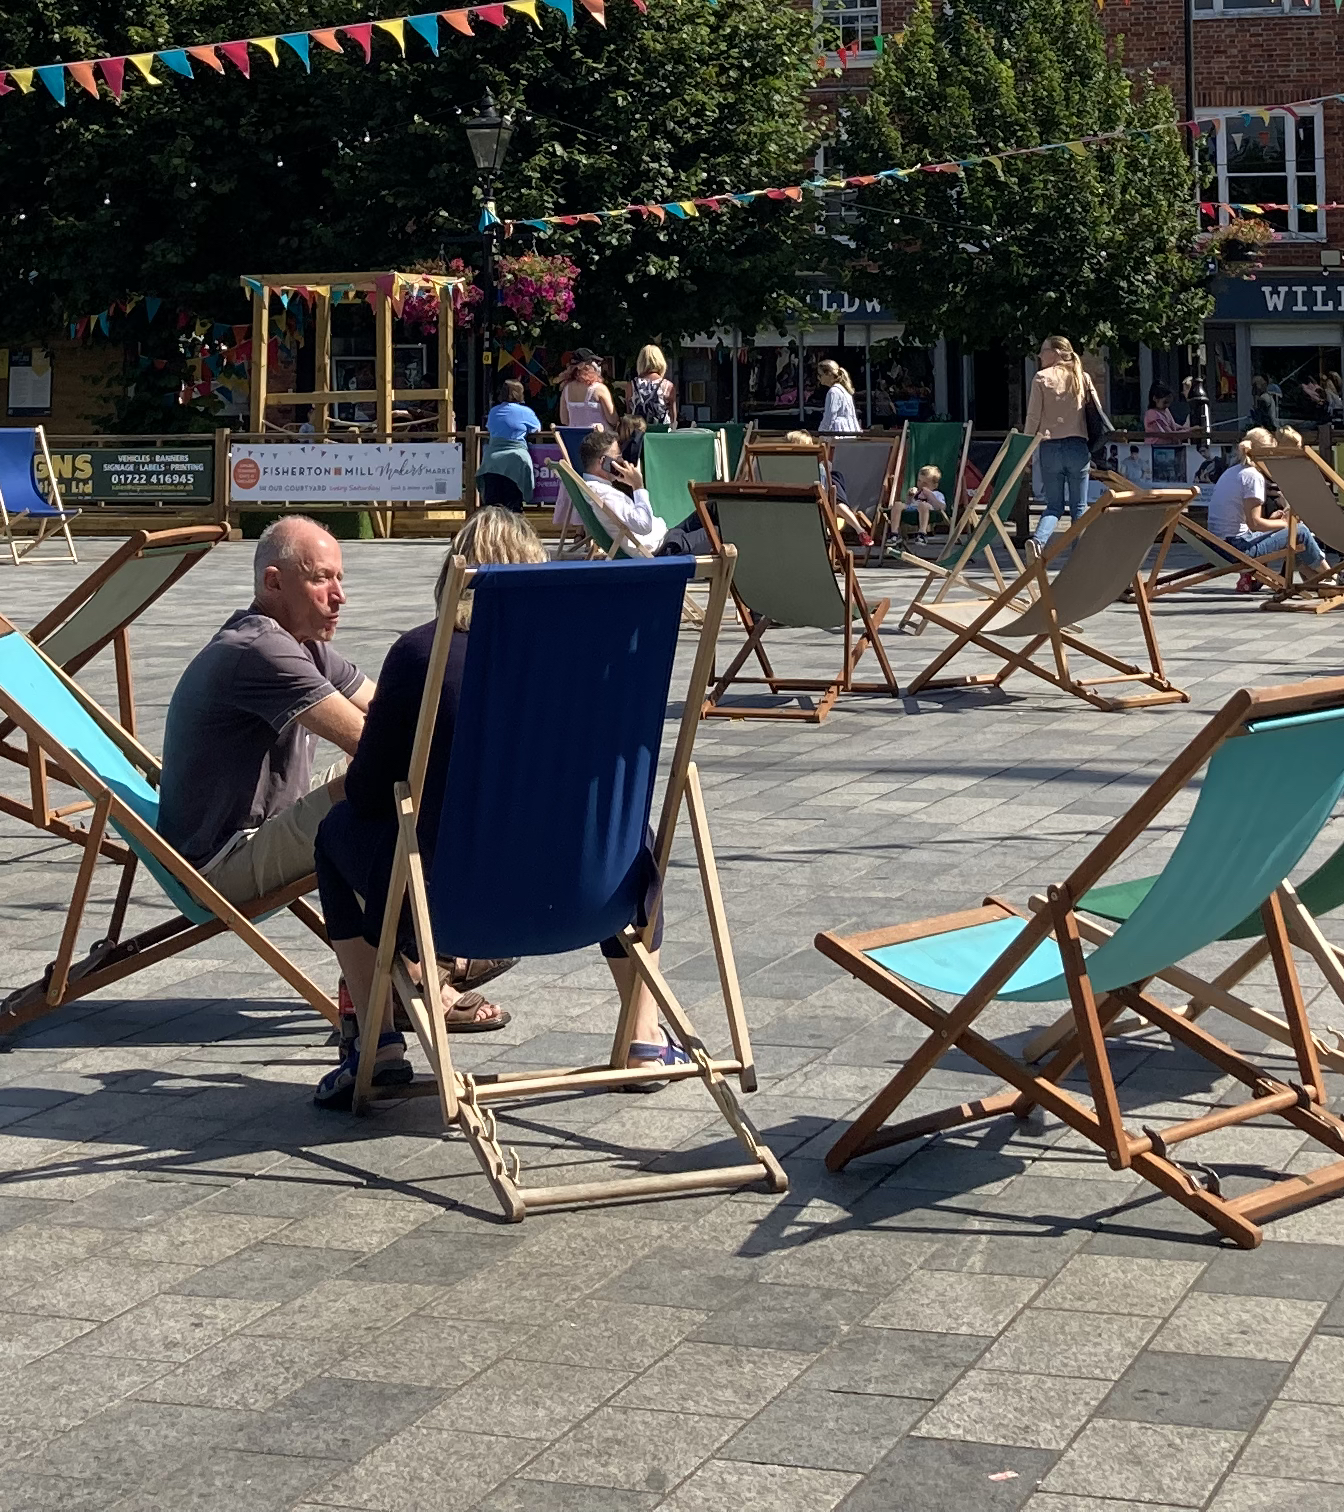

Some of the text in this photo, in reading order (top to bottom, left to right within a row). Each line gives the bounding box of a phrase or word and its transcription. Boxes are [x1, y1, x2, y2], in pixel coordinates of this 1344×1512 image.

[118, 454, 189, 462] VEHICLES BANNERS
[103, 463, 204, 471] SIGNAGE LABELS PRINTING
[262, 467, 331, 476] FISHERTON
[344, 467, 373, 476] MILL
[111, 474, 194, 484] 01722 416945
[71, 480, 93, 494] Ltd
